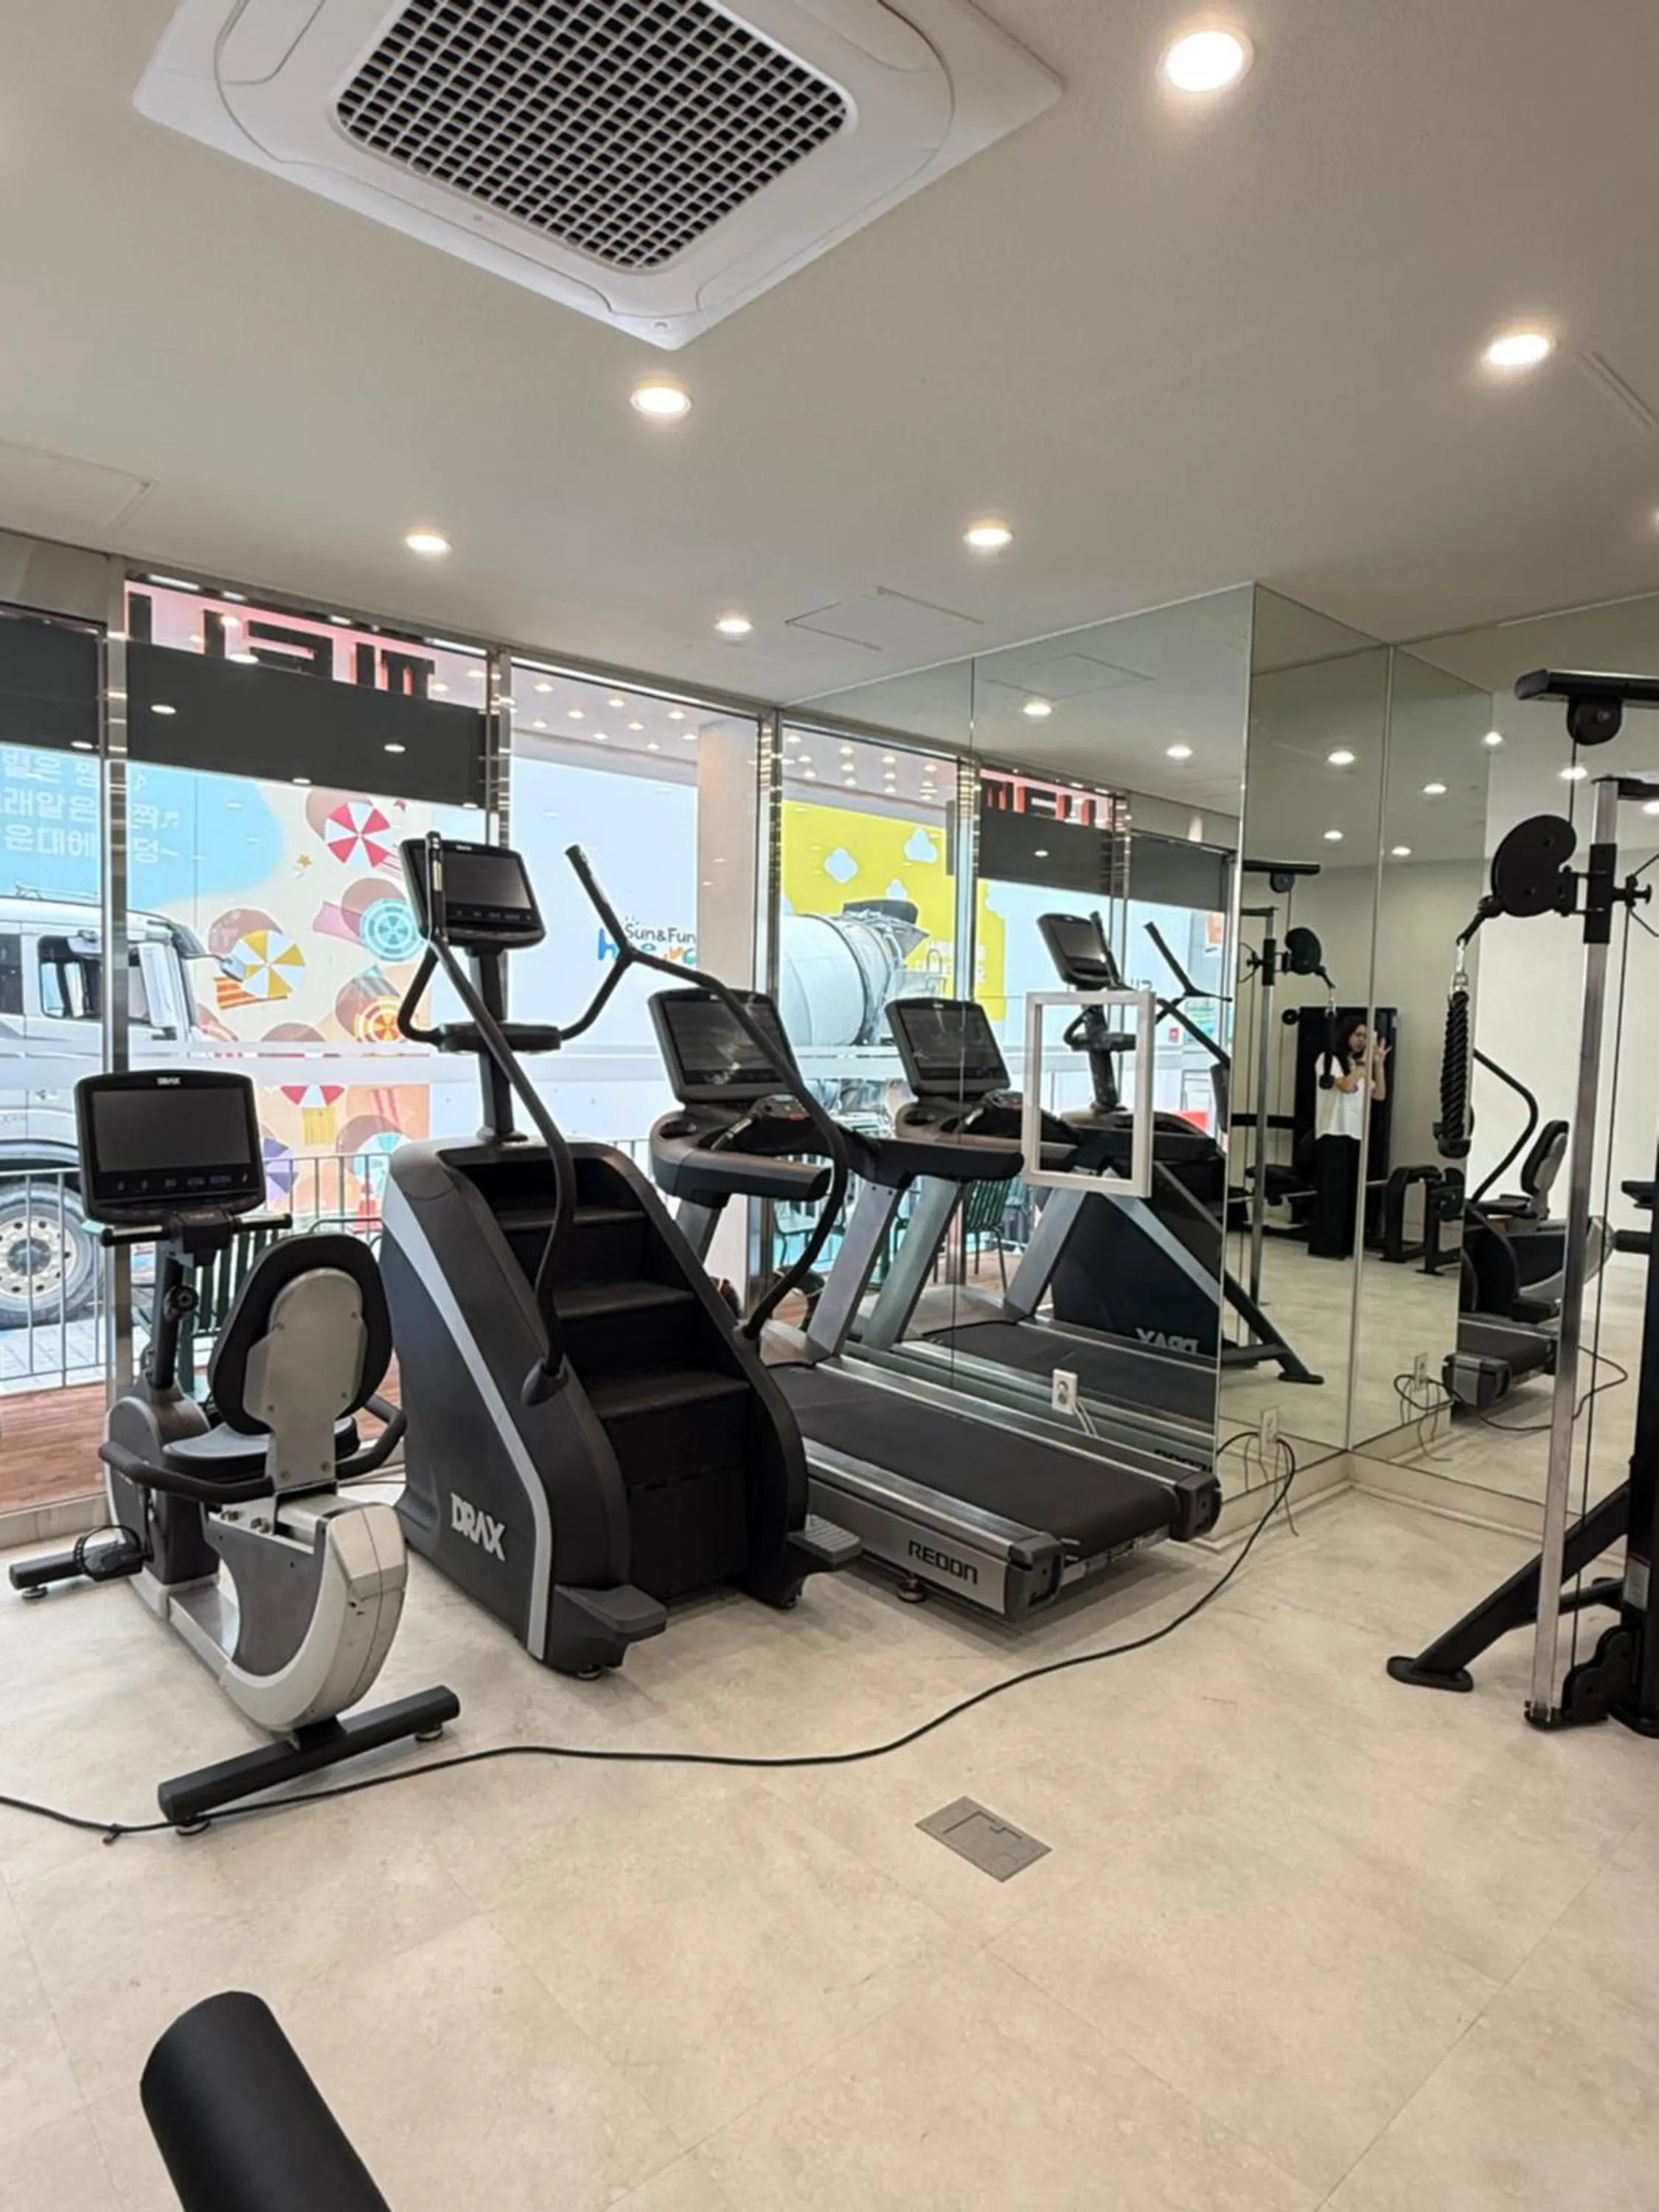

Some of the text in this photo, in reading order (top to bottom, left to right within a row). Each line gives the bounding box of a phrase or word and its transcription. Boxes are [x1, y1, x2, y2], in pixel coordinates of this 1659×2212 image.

[0, 786, 97, 822] 래알은
[625, 924, 696, 943] Sun&Fun
[451, 1492, 506, 1562] DRAX
